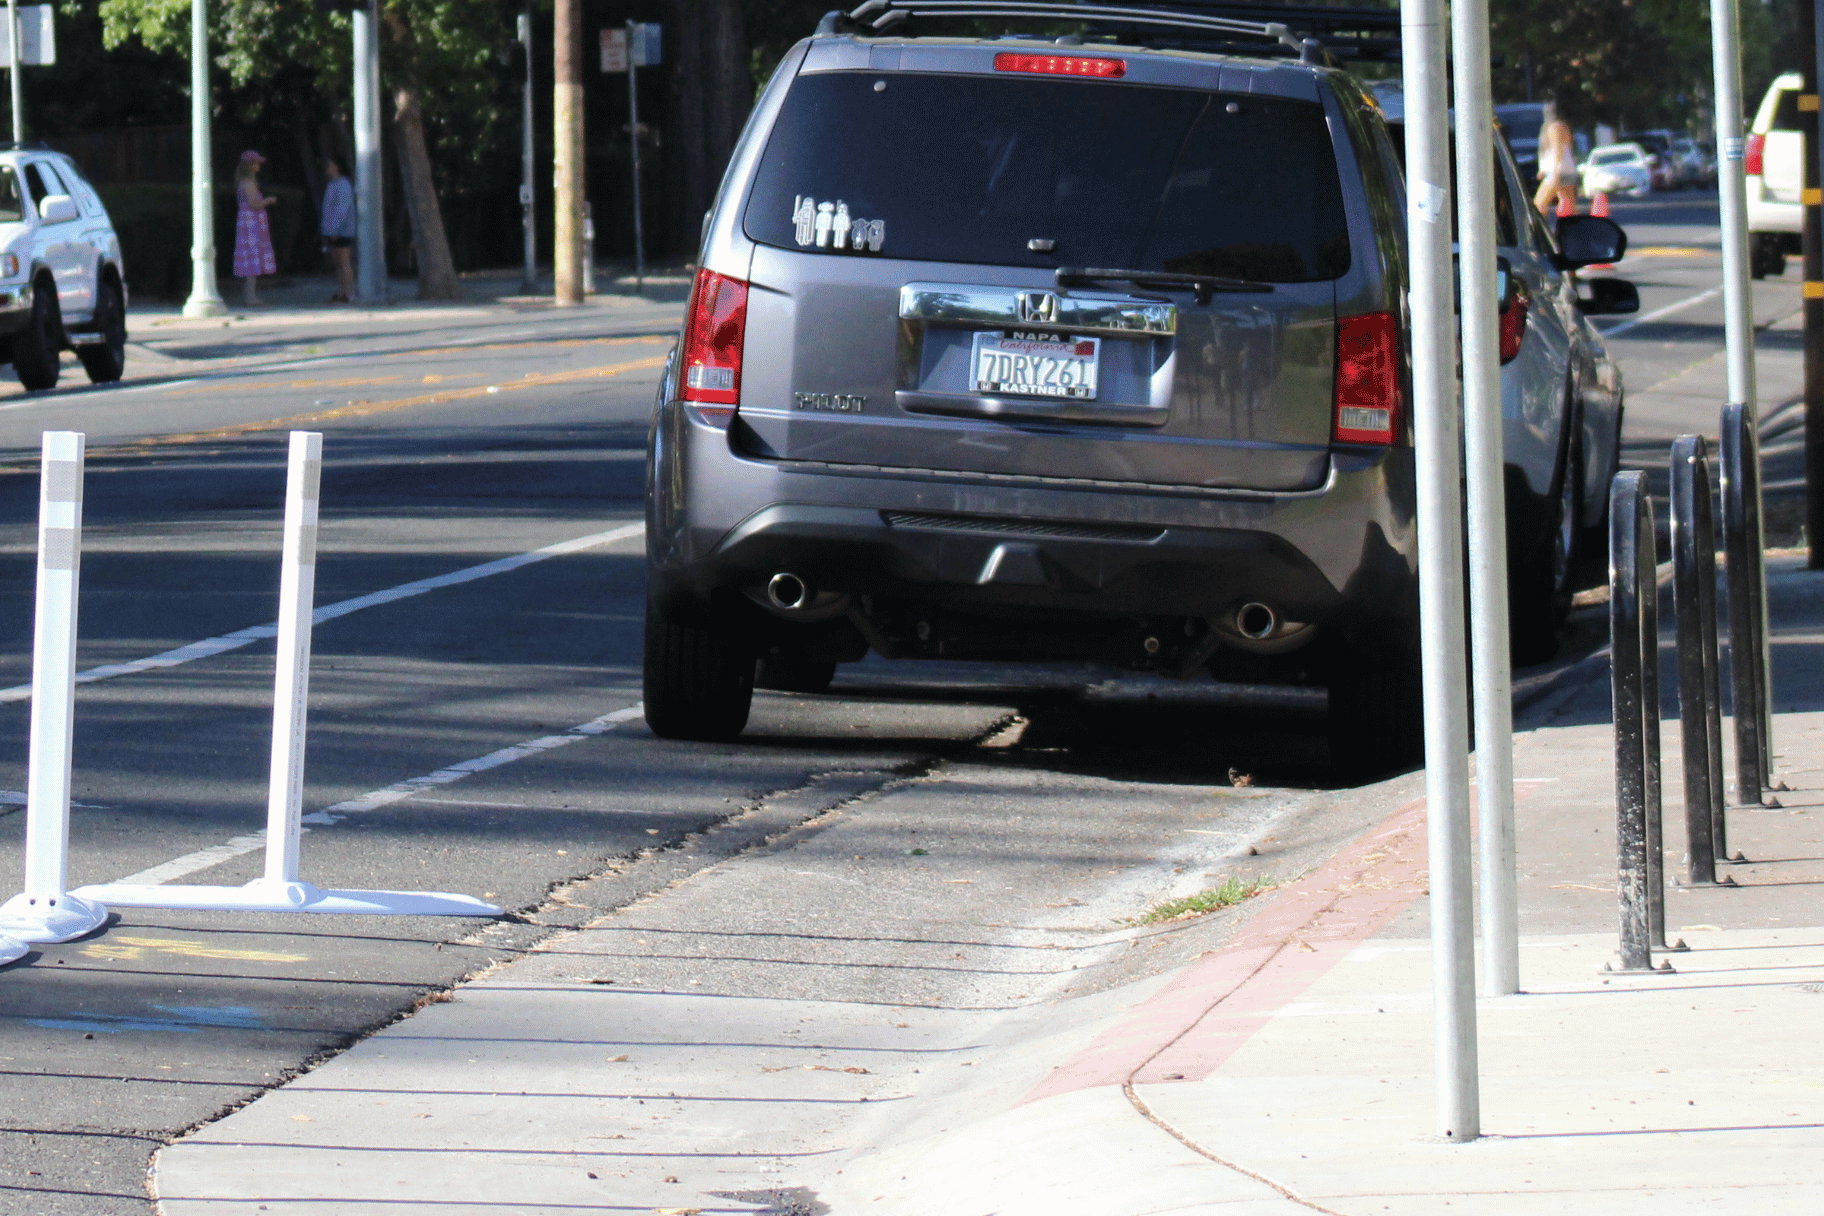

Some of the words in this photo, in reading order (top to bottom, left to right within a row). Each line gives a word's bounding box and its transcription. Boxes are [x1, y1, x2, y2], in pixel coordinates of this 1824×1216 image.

[1012, 331, 1061, 342] NAPA
[982, 353, 1089, 387] 7DRY261
[999, 383, 1067, 396] KASTNER
